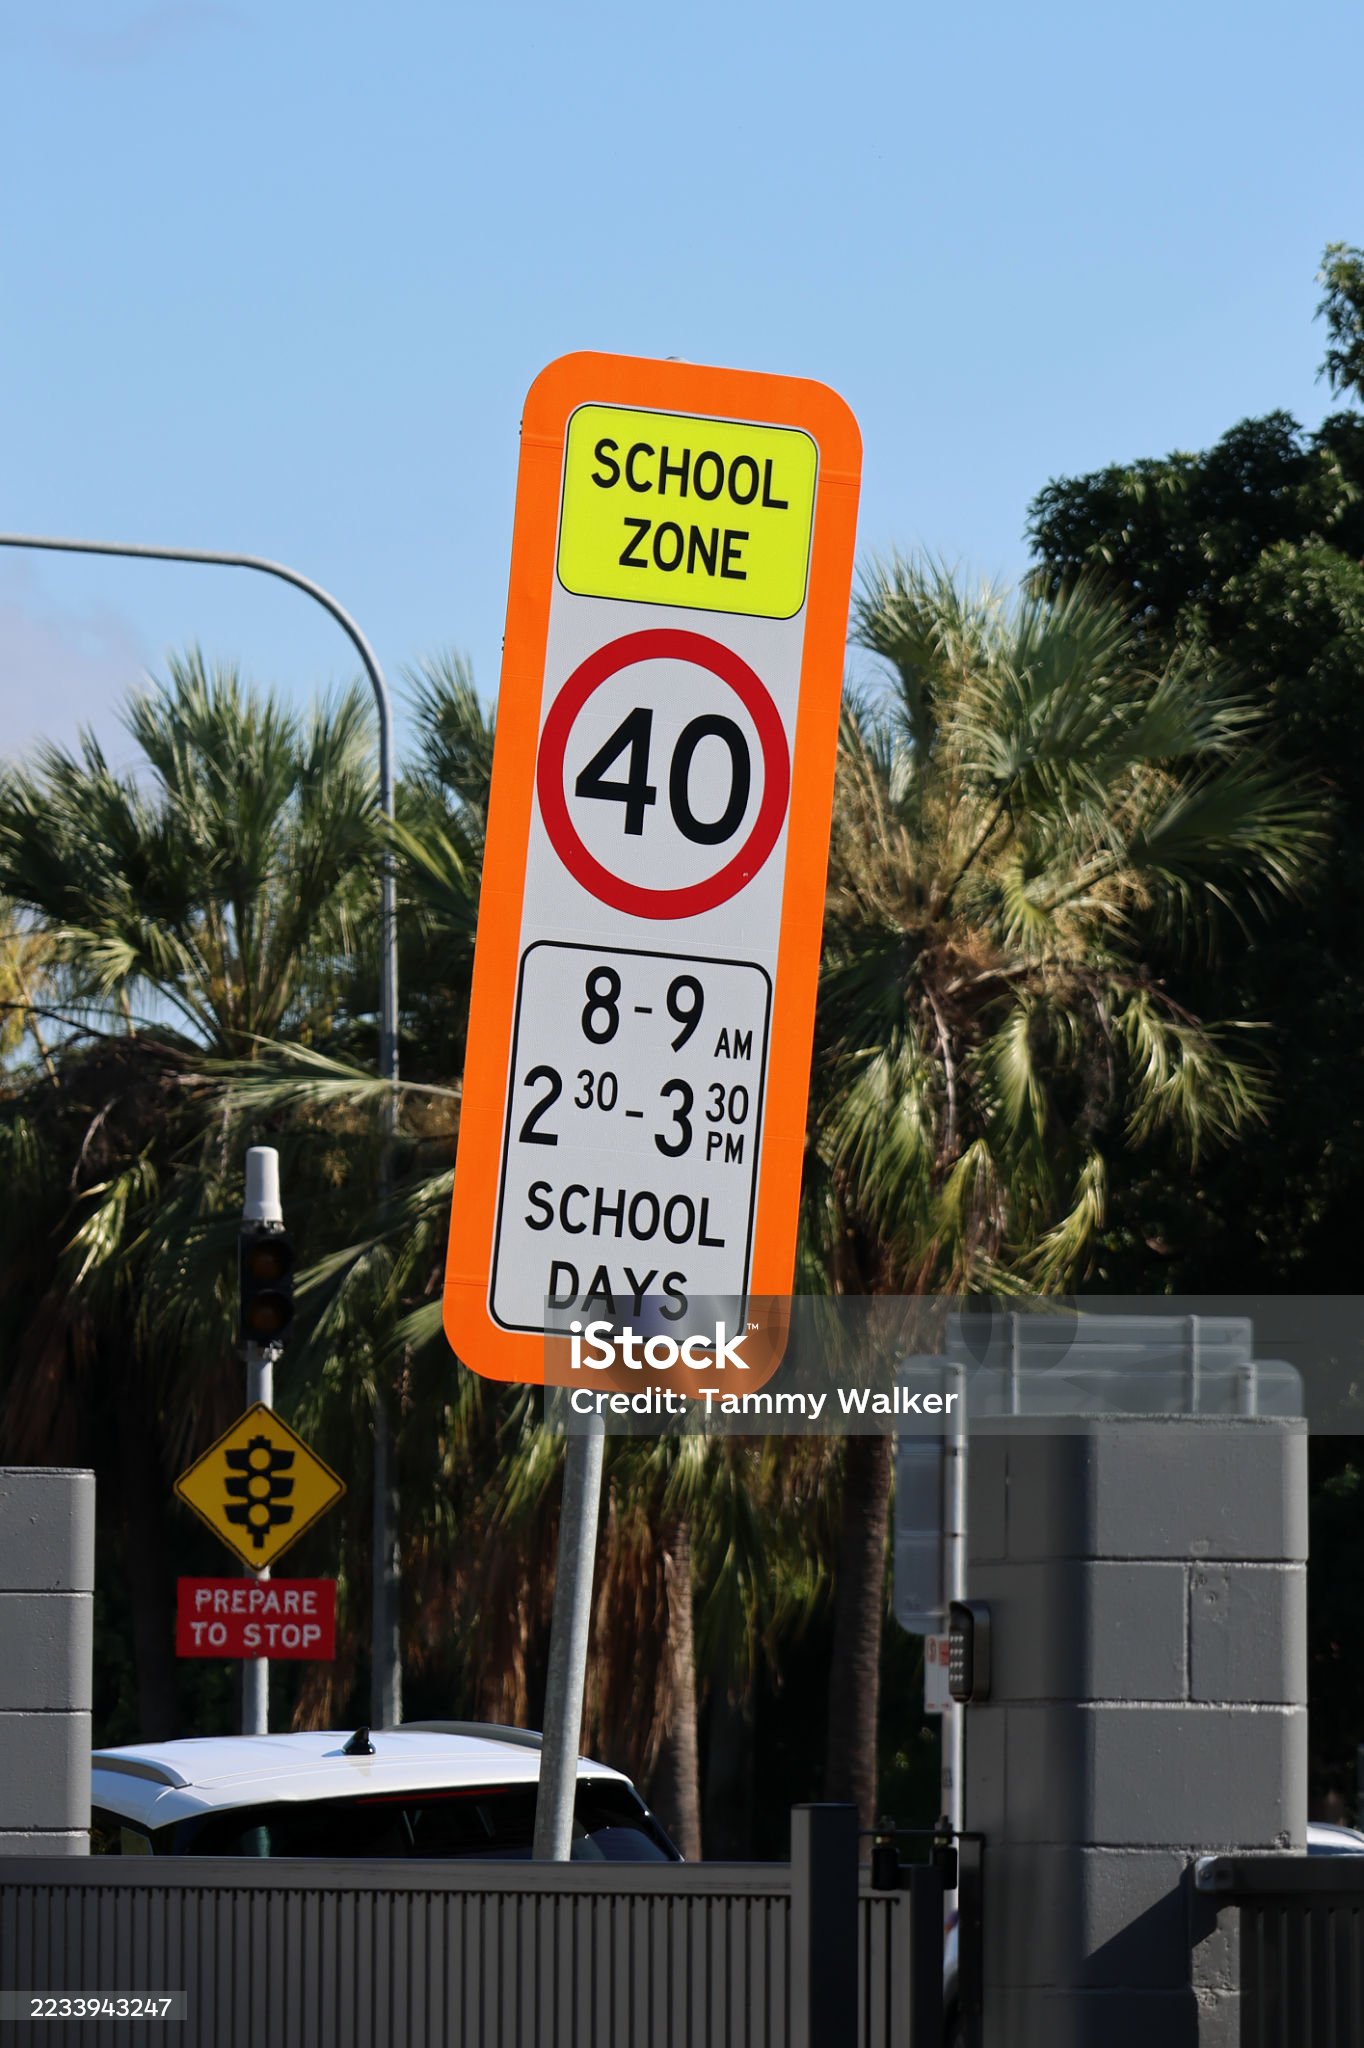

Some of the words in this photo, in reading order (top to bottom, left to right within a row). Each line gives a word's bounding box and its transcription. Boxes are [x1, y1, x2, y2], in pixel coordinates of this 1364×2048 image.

[591, 438, 789, 510] SCHOOL
[619, 517, 749, 580] ZONE
[575, 707, 750, 845] 40
[714, 1027, 753, 1061] AM
[706, 1131, 745, 1164] PM
[524, 1180, 725, 1248] SCHOOL
[548, 1260, 688, 1321] DAYS
[195, 1588, 318, 1615] PREPARE
[190, 1621, 228, 1647] TO
[243, 1623, 321, 1648] STOP
